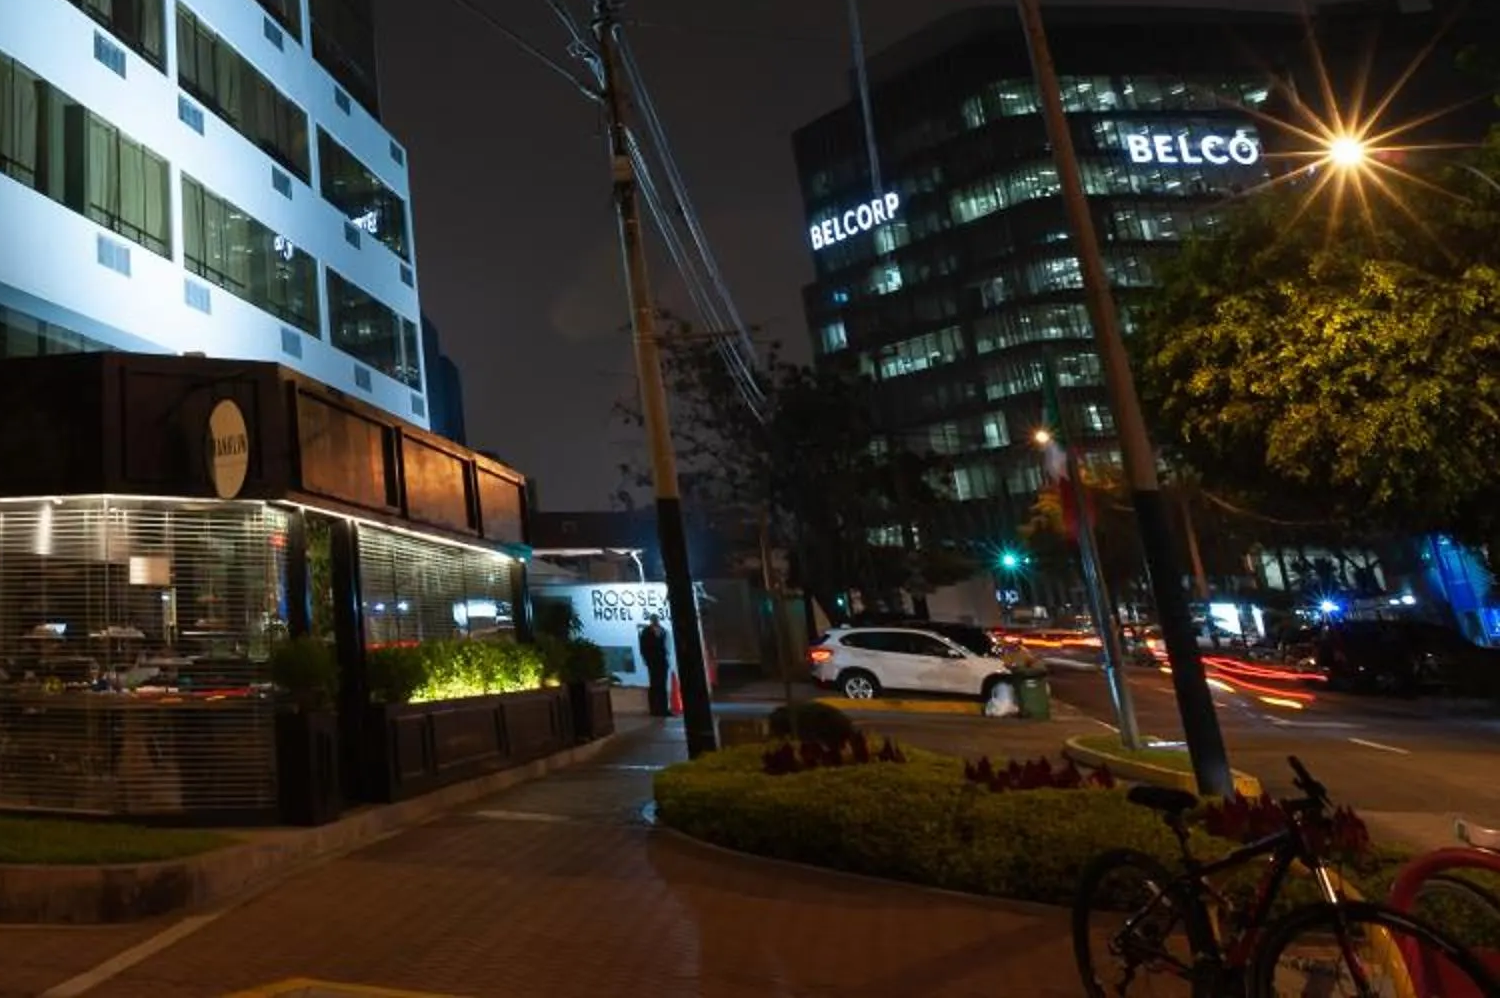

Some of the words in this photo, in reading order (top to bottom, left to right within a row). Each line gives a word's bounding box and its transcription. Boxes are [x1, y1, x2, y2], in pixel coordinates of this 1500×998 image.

[810, 192, 899, 251] BELCORP
[591, 589, 670, 607] ROOSEV
[593, 607, 633, 621] HOTEL
